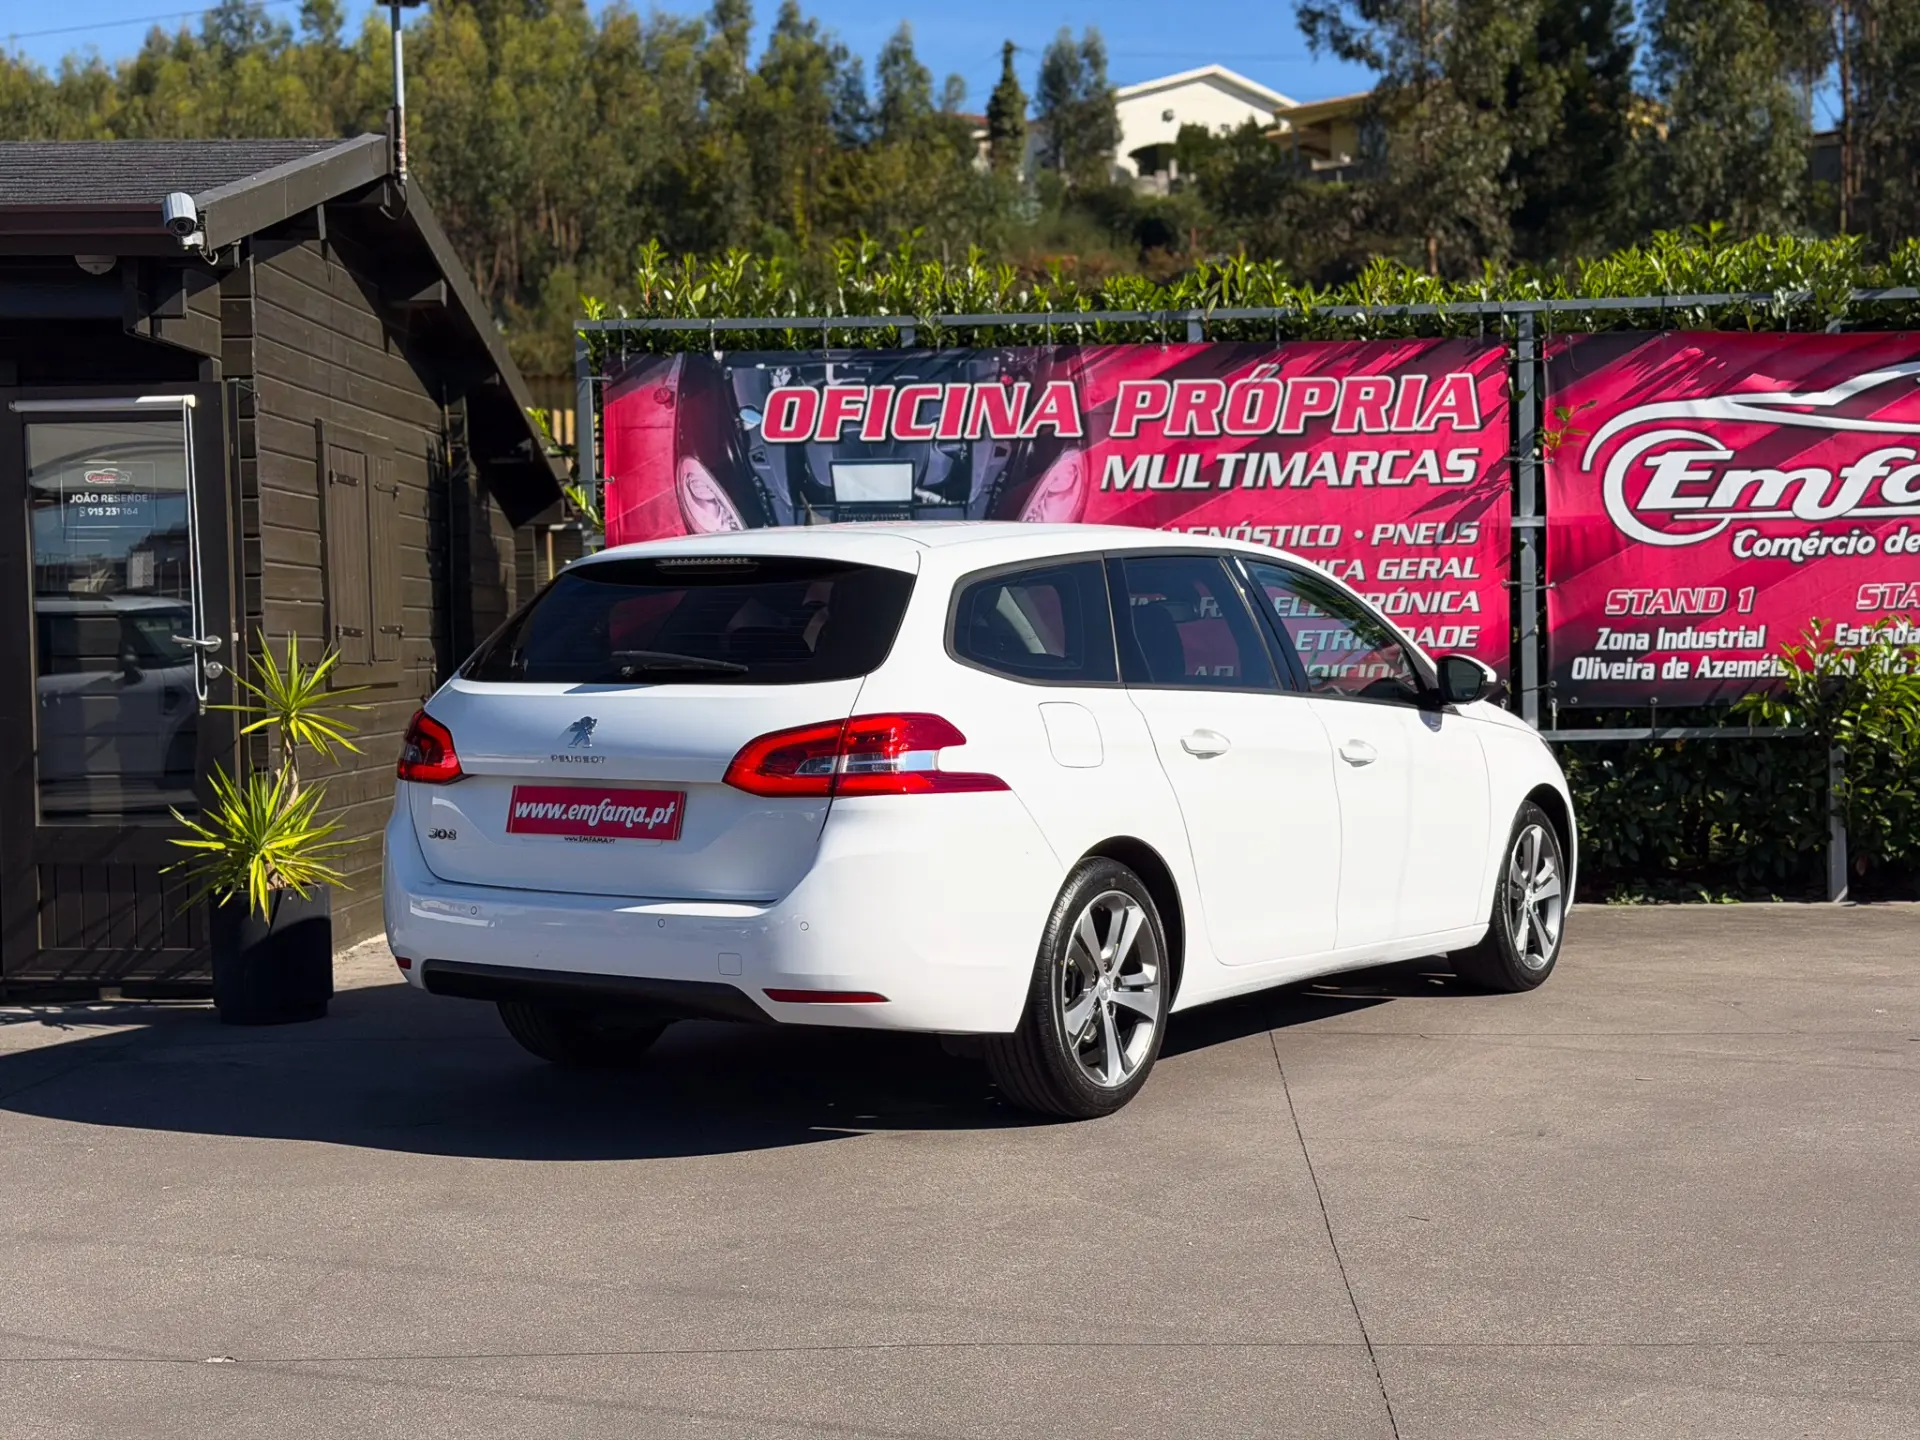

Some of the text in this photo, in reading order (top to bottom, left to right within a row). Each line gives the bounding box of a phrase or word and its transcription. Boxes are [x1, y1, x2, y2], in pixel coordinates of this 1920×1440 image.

[760, 363, 1481, 442] OFICINA PRÓPRIA
[1100, 447, 1480, 490] MULTIMARCAS
[69, 491, 148, 503] JOÃO RESENDE
[87, 507, 139, 516] 915 231 164
[1371, 521, 1480, 546] PNEUS
[1733, 526, 1920, 563] Comércio de
[1376, 556, 1480, 580] GERAL
[1605, 586, 1755, 615] STAND 1
[1595, 625, 1766, 651] Zona Industrial
[1571, 656, 1656, 680] Oliveira
[1661, 656, 1690, 680] de
[550, 754, 606, 764] PEUGEOT
[514, 797, 675, 830] www.emfama.pt
[427, 827, 457, 841] 308
